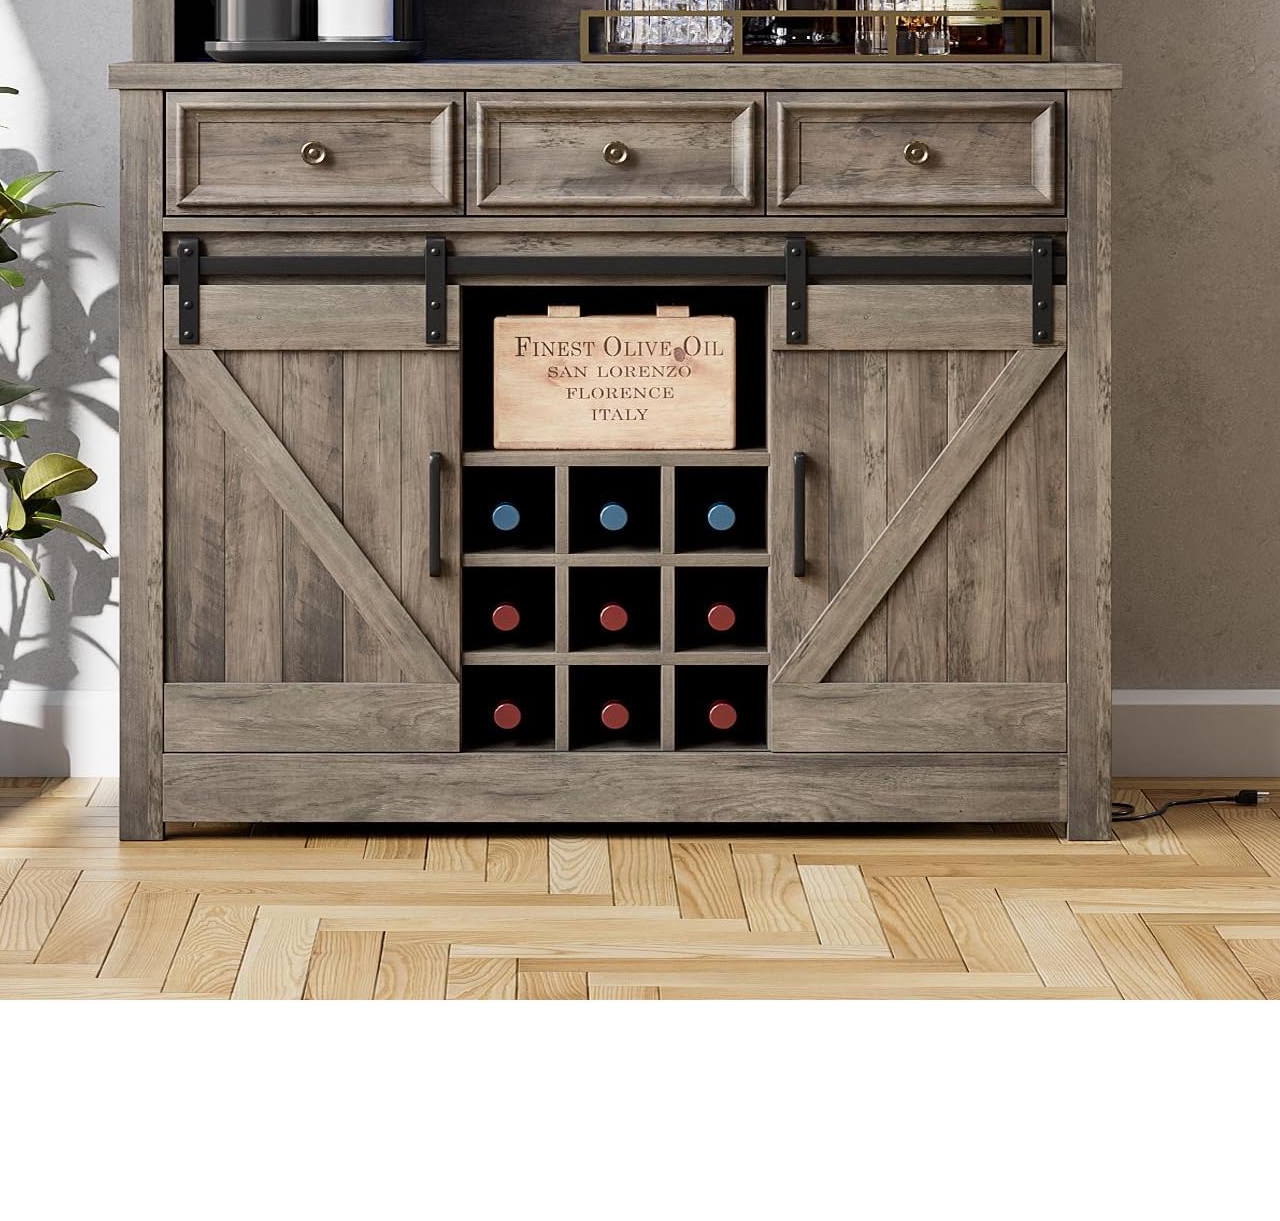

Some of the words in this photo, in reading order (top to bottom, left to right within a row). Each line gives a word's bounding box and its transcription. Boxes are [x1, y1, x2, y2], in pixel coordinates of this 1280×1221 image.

[547, 365, 587, 379] SAN
[597, 365, 692, 379] LORENZO
[566, 387, 675, 400] FLORENCE
[591, 408, 649, 421] ITALY
